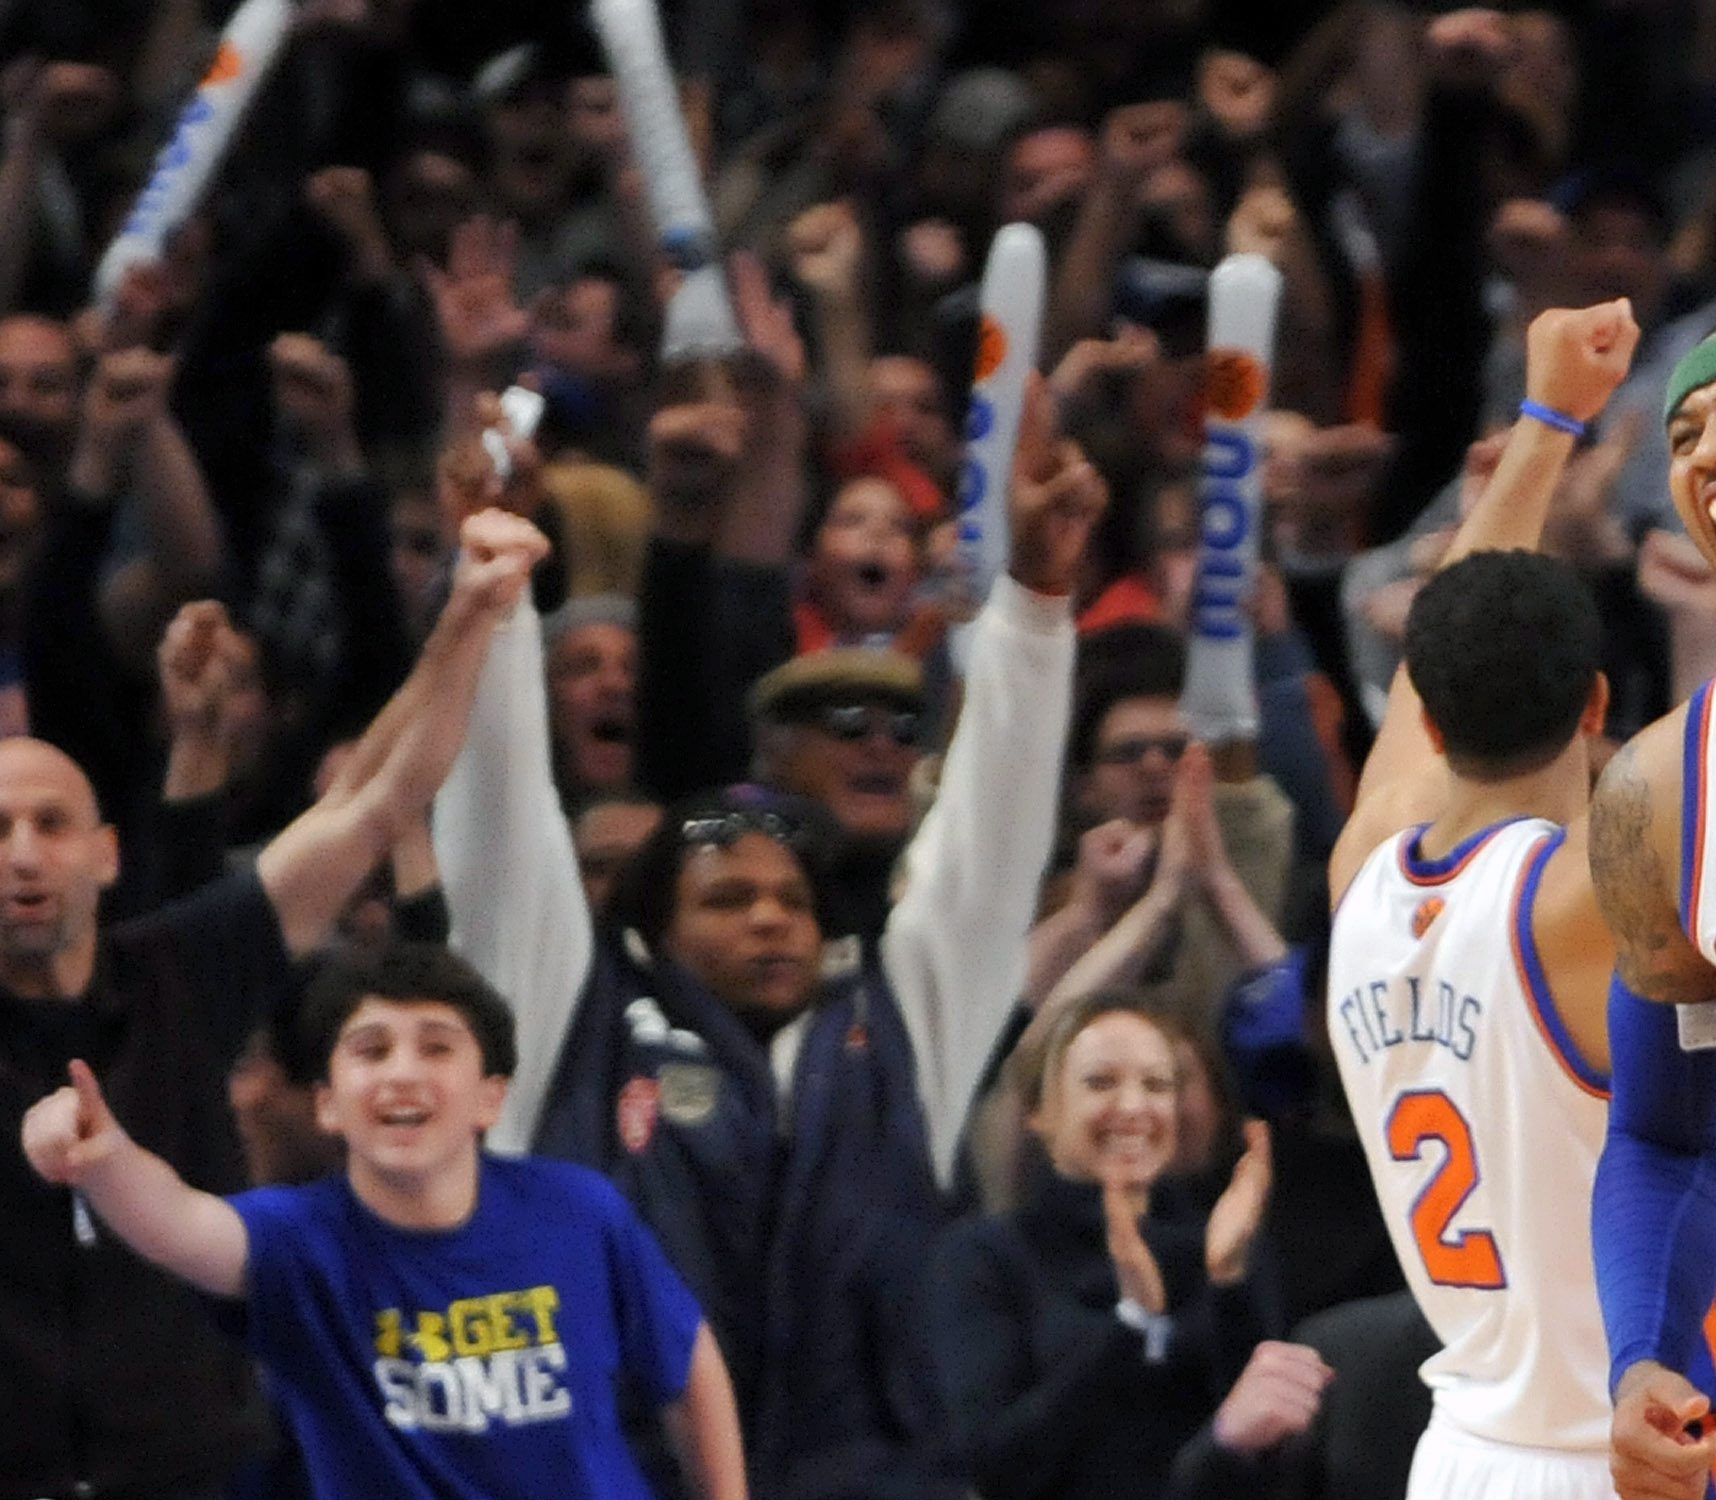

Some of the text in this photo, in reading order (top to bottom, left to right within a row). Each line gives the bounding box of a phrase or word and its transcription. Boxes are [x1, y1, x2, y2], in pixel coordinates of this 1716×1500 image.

[1339, 975, 1482, 1064] FIELDS
[1384, 1087, 1508, 1290] 2
[448, 1284, 560, 1358] GET
[374, 1341, 572, 1433] SOME
